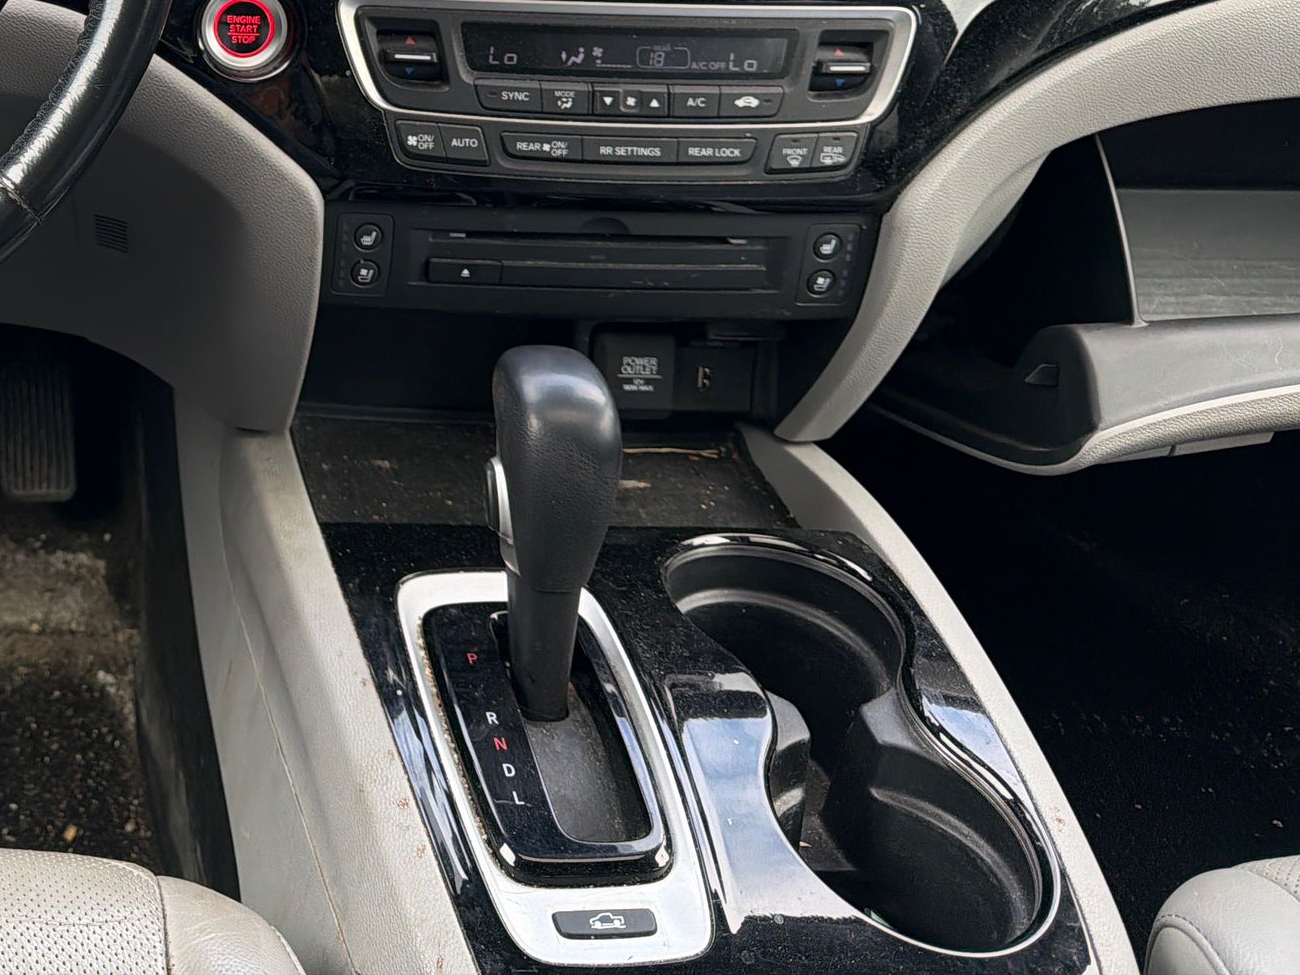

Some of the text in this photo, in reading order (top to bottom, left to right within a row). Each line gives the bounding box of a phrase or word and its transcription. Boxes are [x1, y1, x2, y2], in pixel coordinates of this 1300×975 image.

[226, 15, 261, 24] ENGINE
[230, 25, 258, 33] START
[231, 35, 256, 44] STOP
[691, 61, 727, 70] A/C OFF
[501, 91, 529, 101] SYNC
[554, 90, 575, 98] MODE
[686, 97, 706, 107] A/C
[418, 134, 435, 142] ON/
[451, 137, 478, 148] AUTO
[418, 142, 435, 150] OFF
[516, 141, 541, 151] REAR
[551, 140, 568, 149] ON/
[551, 148, 569, 157] OFF
[600, 146, 661, 157] RR SETTINGS
[688, 147, 741, 158] REAR LOCK
[782, 147, 808, 156] FRONT
[823, 145, 842, 154] REAR
[622, 356, 659, 365] POWER
[621, 365, 659, 375] OUTLET
[466, 652, 478, 665] P
[485, 711, 499, 725] R
[493, 737, 508, 751] N
[502, 763, 516, 777] D
[512, 791, 525, 805] L
